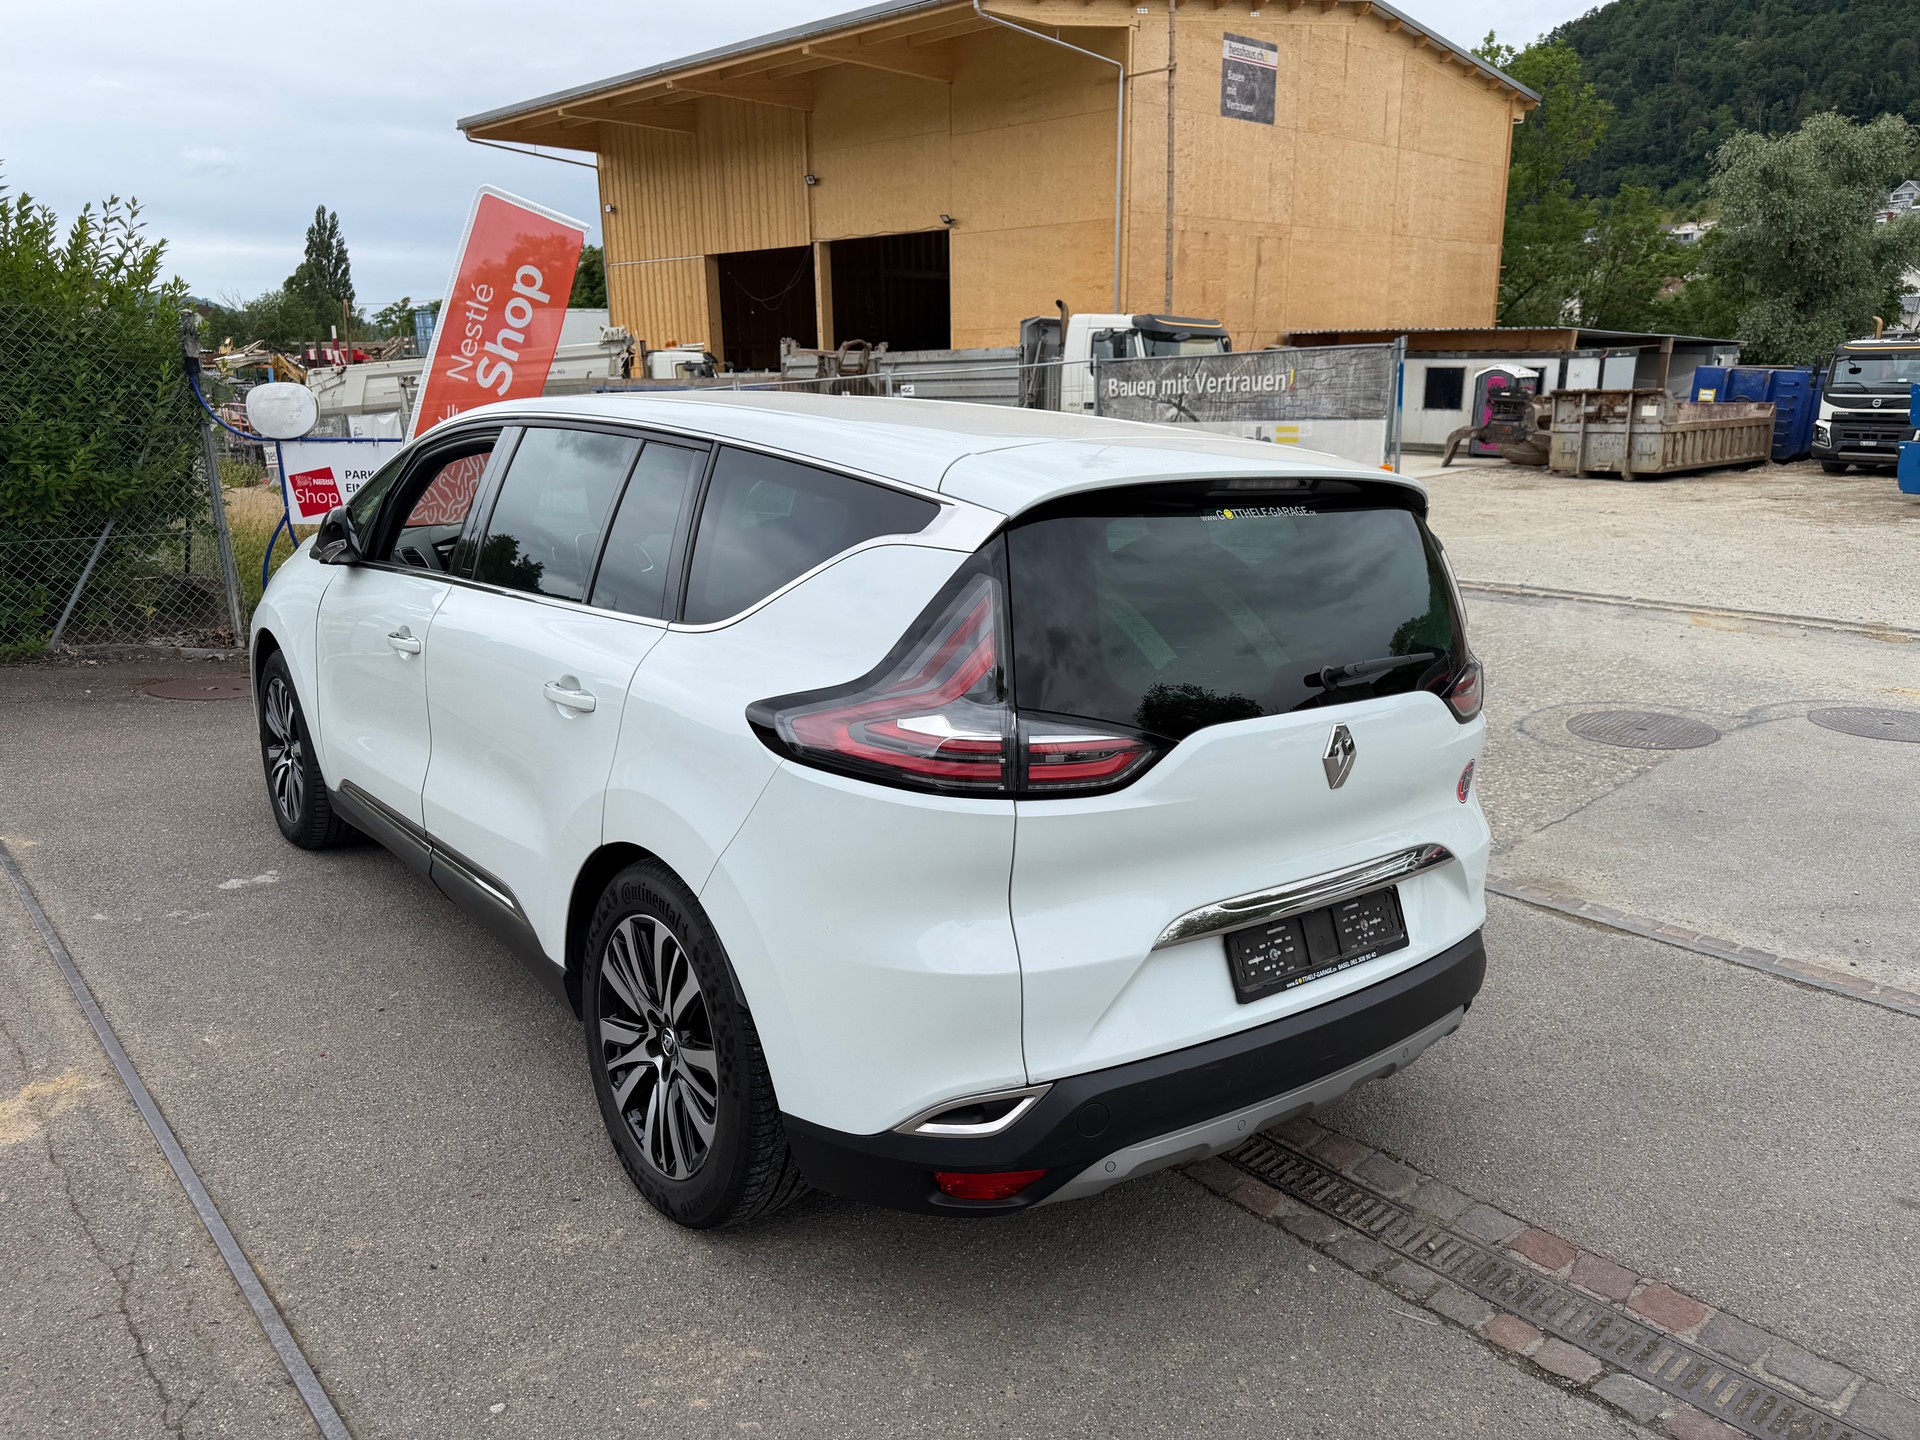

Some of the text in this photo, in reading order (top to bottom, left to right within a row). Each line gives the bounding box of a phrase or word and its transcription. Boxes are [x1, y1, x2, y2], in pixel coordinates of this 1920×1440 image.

[1226, 85, 1238, 95] mit
[446, 282, 495, 382] Nestlé
[475, 264, 551, 397] Shop
[1107, 377, 1157, 398] Bauen
[1161, 373, 1190, 395] mit
[1195, 368, 1295, 393] Vertrauen!
[295, 487, 339, 508] Shop
[621, 881, 682, 930] Continental
